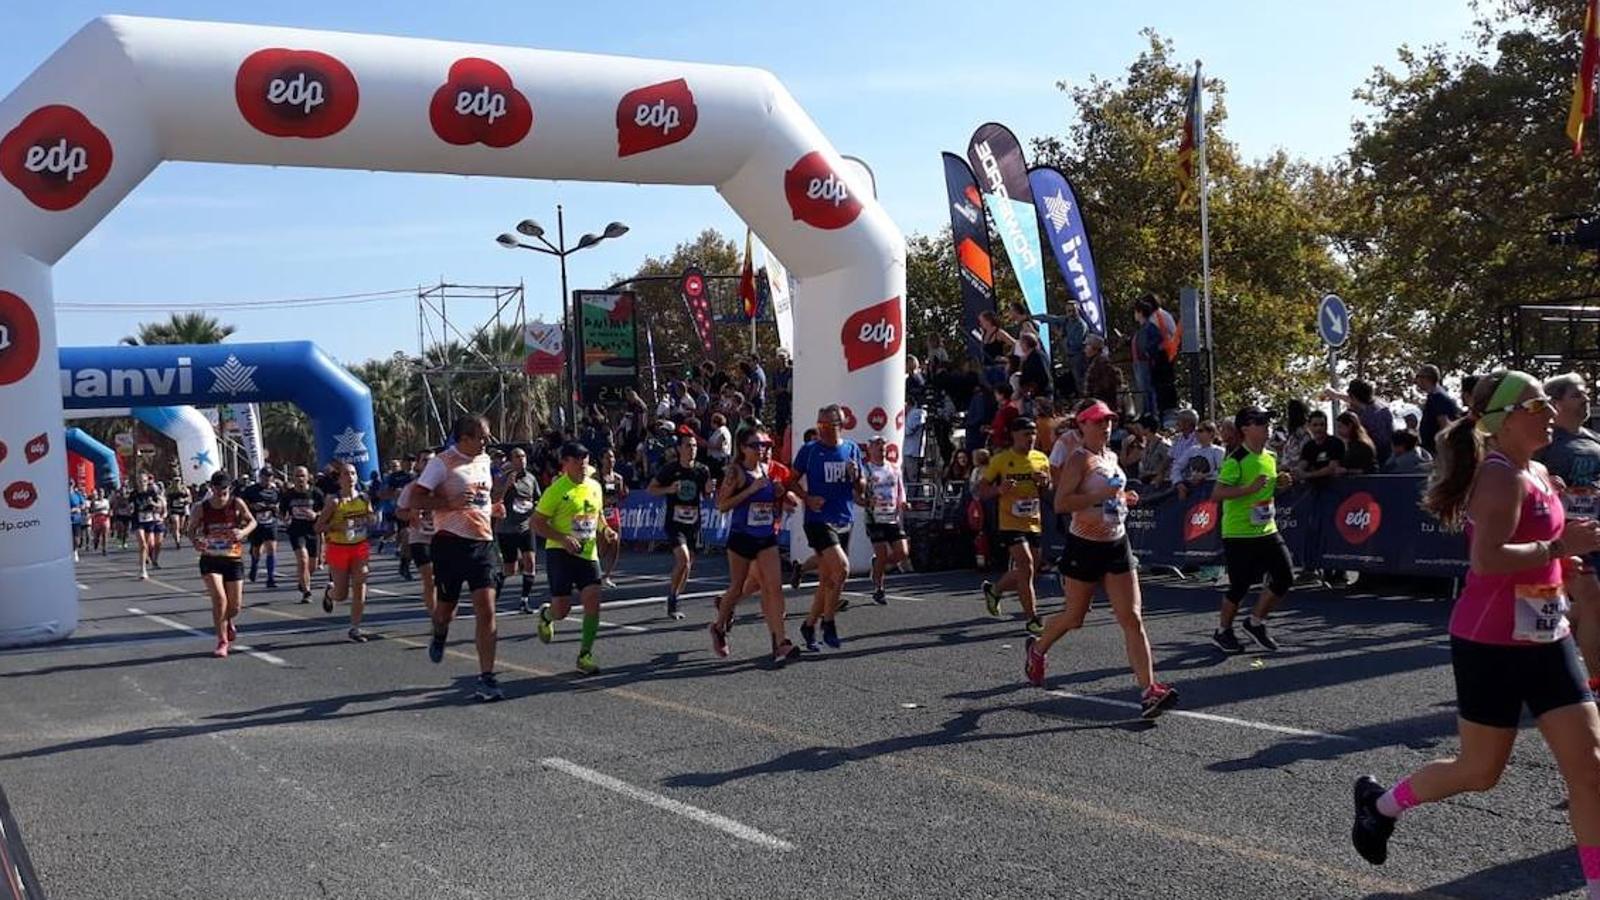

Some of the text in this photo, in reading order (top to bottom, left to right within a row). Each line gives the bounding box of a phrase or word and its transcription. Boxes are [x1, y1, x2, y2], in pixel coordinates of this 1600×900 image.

[266, 73, 325, 114] edp
[455, 86, 507, 124] edp
[634, 100, 681, 135] edp
[24, 138, 89, 181] edp
[807, 174, 848, 207] edp
[858, 317, 895, 349] edp
[12, 488, 30, 502] edp
[1191, 510, 1210, 528] edp
[1345, 508, 1371, 529] edp
